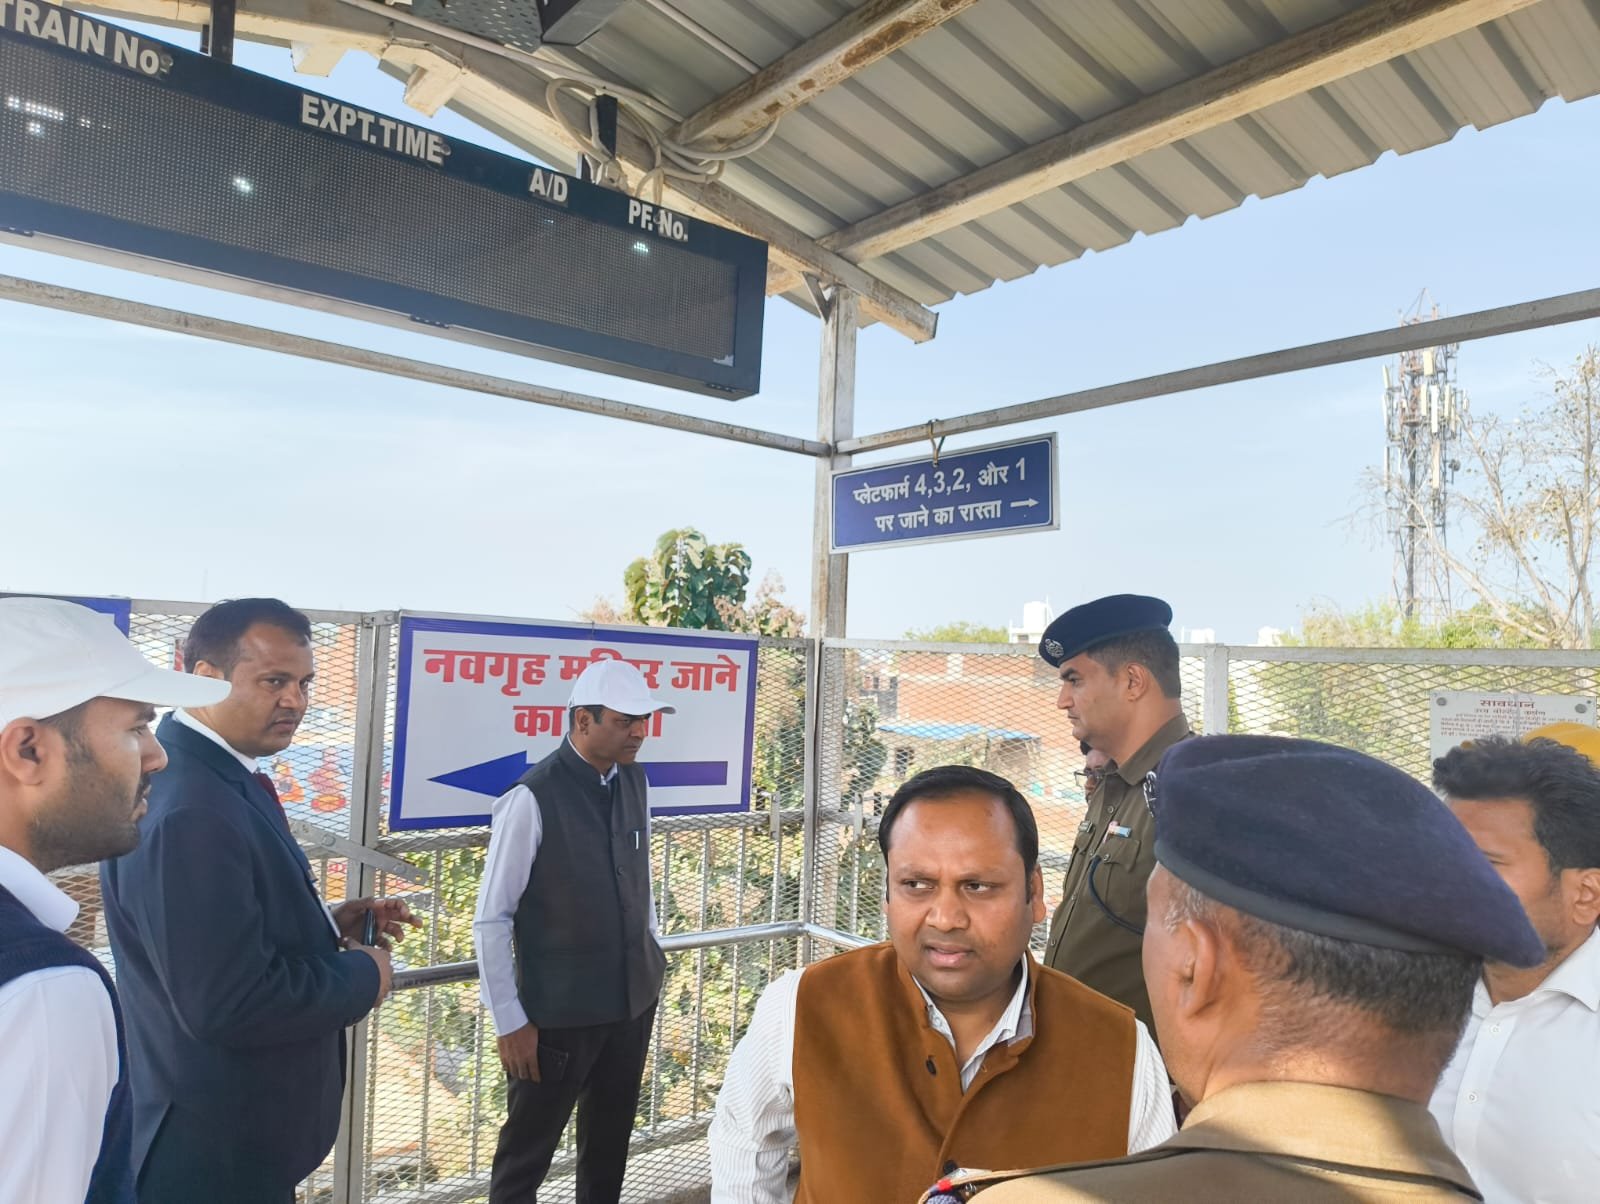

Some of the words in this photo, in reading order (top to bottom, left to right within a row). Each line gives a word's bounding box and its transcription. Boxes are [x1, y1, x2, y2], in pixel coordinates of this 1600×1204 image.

[0, 0, 107, 57] TRAIN
[528, 168, 569, 202] A/D
[628, 199, 654, 231] PF.
[658, 209, 689, 241] No.
[853, 475, 909, 504] प्लेटफार्म
[914, 468, 970, 498] 4,3,2,
[978, 462, 1009, 485] और
[1015, 457, 1026, 481] 1
[874, 514, 895, 532] पर
[897, 504, 929, 529] जाने
[932, 506, 955, 525] का
[958, 500, 1002, 521] रास्ता
[424, 649, 550, 696] नवगृह
[671, 654, 741, 692] जाने
[513, 705, 567, 737] का
